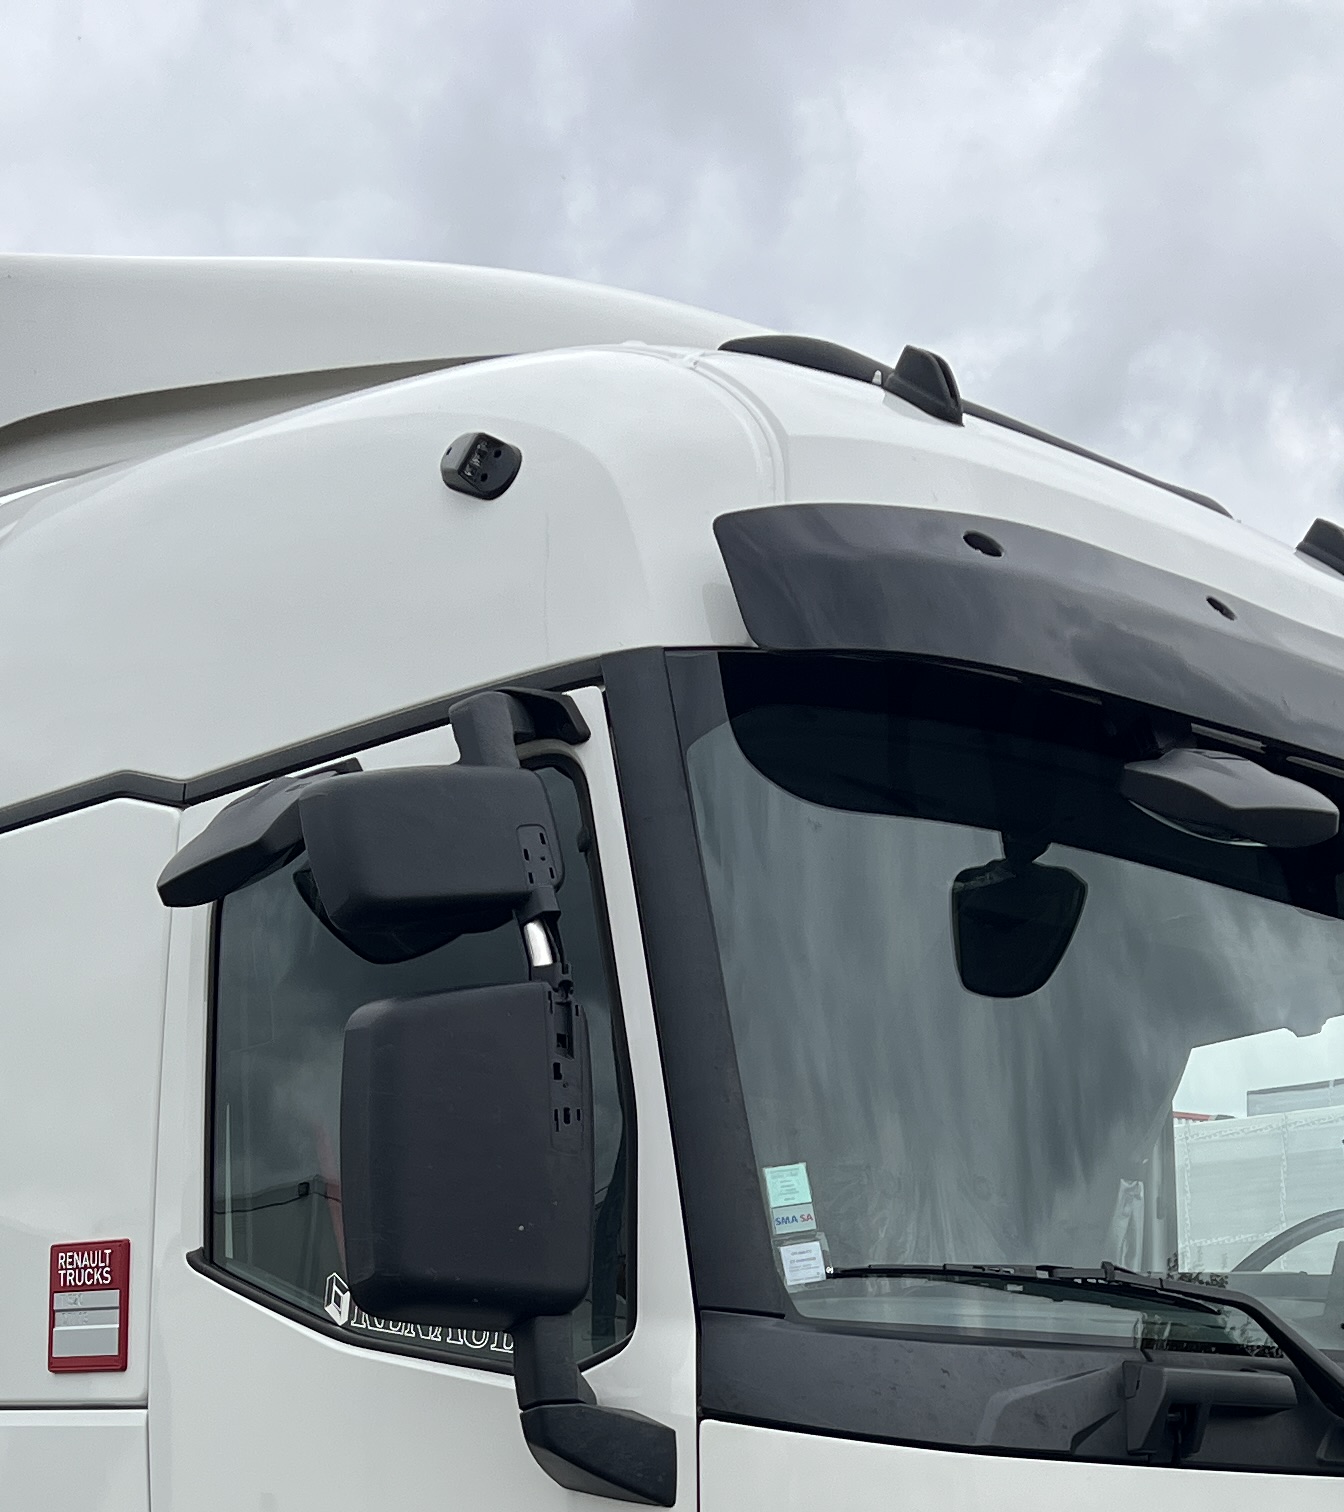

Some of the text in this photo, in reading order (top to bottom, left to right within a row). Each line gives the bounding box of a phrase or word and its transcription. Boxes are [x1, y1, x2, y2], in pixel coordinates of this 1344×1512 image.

[775, 1213, 814, 1226] SMA SA
[58, 1249, 112, 1270] RENAULT
[58, 1267, 112, 1287] TRUCKS
